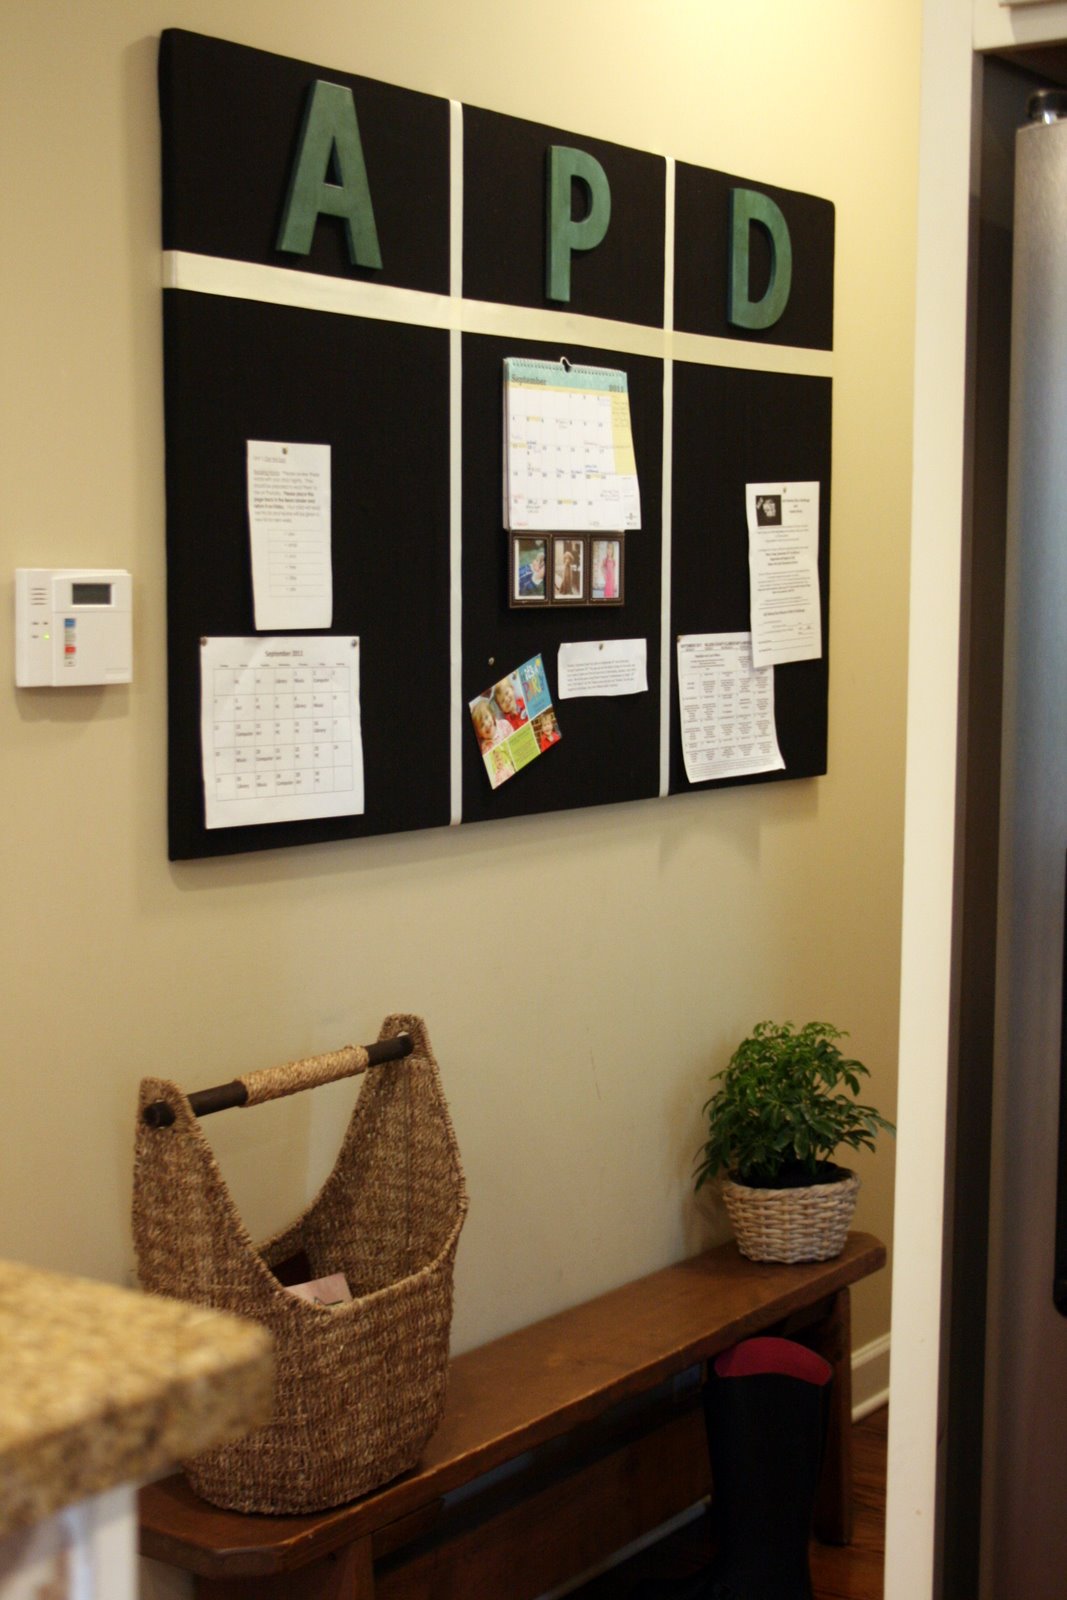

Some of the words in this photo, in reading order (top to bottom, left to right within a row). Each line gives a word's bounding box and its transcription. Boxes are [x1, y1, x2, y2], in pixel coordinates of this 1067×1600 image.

[275, 79, 383, 270] A
[546, 144, 612, 303] P
[728, 187, 793, 330] D
[511, 373, 546, 387] September
